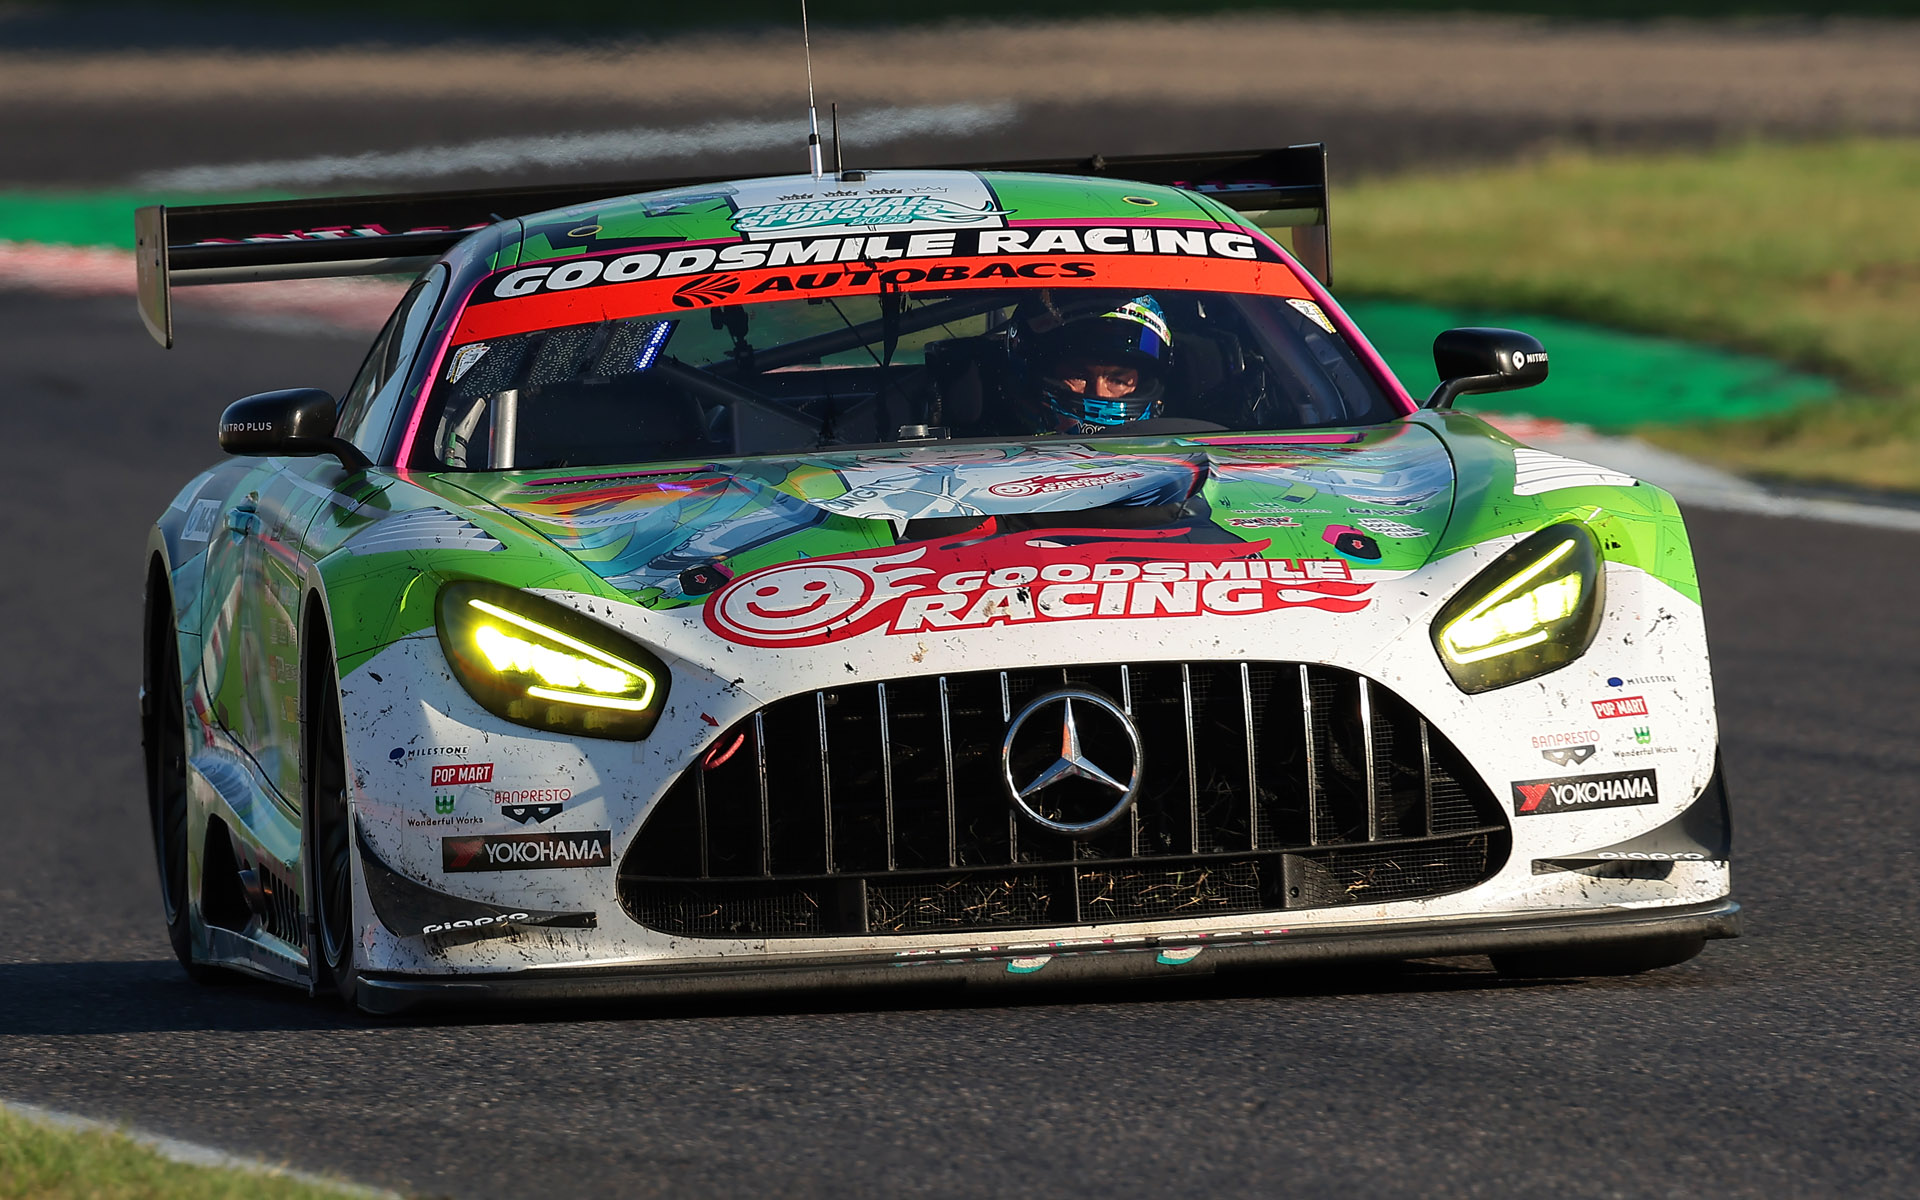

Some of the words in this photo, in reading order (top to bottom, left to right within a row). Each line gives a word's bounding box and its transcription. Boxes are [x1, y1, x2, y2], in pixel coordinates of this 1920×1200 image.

[733, 196, 927, 220] PERSONAL
[738, 203, 945, 229] SPONSORS
[849, 215, 914, 226] 2022
[494, 232, 957, 298] GOODSMILE
[977, 228, 1258, 259] RACING
[744, 261, 1097, 295] AUTOBACS
[222, 423, 245, 432] NITRO
[246, 422, 272, 431] PLUS
[1041, 476, 1122, 493] RACING
[936, 560, 1347, 594] GOODSMILE
[895, 580, 1264, 630] RACING
[1627, 675, 1677, 685] MILESTONE
[1594, 701, 1616, 716] POP
[1617, 699, 1647, 714] MART
[1532, 730, 1600, 749] BANPRESTO
[407, 746, 468, 758] MILESTONE
[1613, 747, 1653, 758] Wonderful
[1655, 746, 1678, 755] Works
[433, 768, 455, 783] POP
[458, 766, 491, 782] MART
[494, 788, 572, 804] BANPRESTO
[1550, 777, 1654, 805] YOKOHAMA
[408, 817, 454, 826] Wonderful
[456, 816, 483, 825] Works
[485, 839, 605, 864] YOKOHAMA
